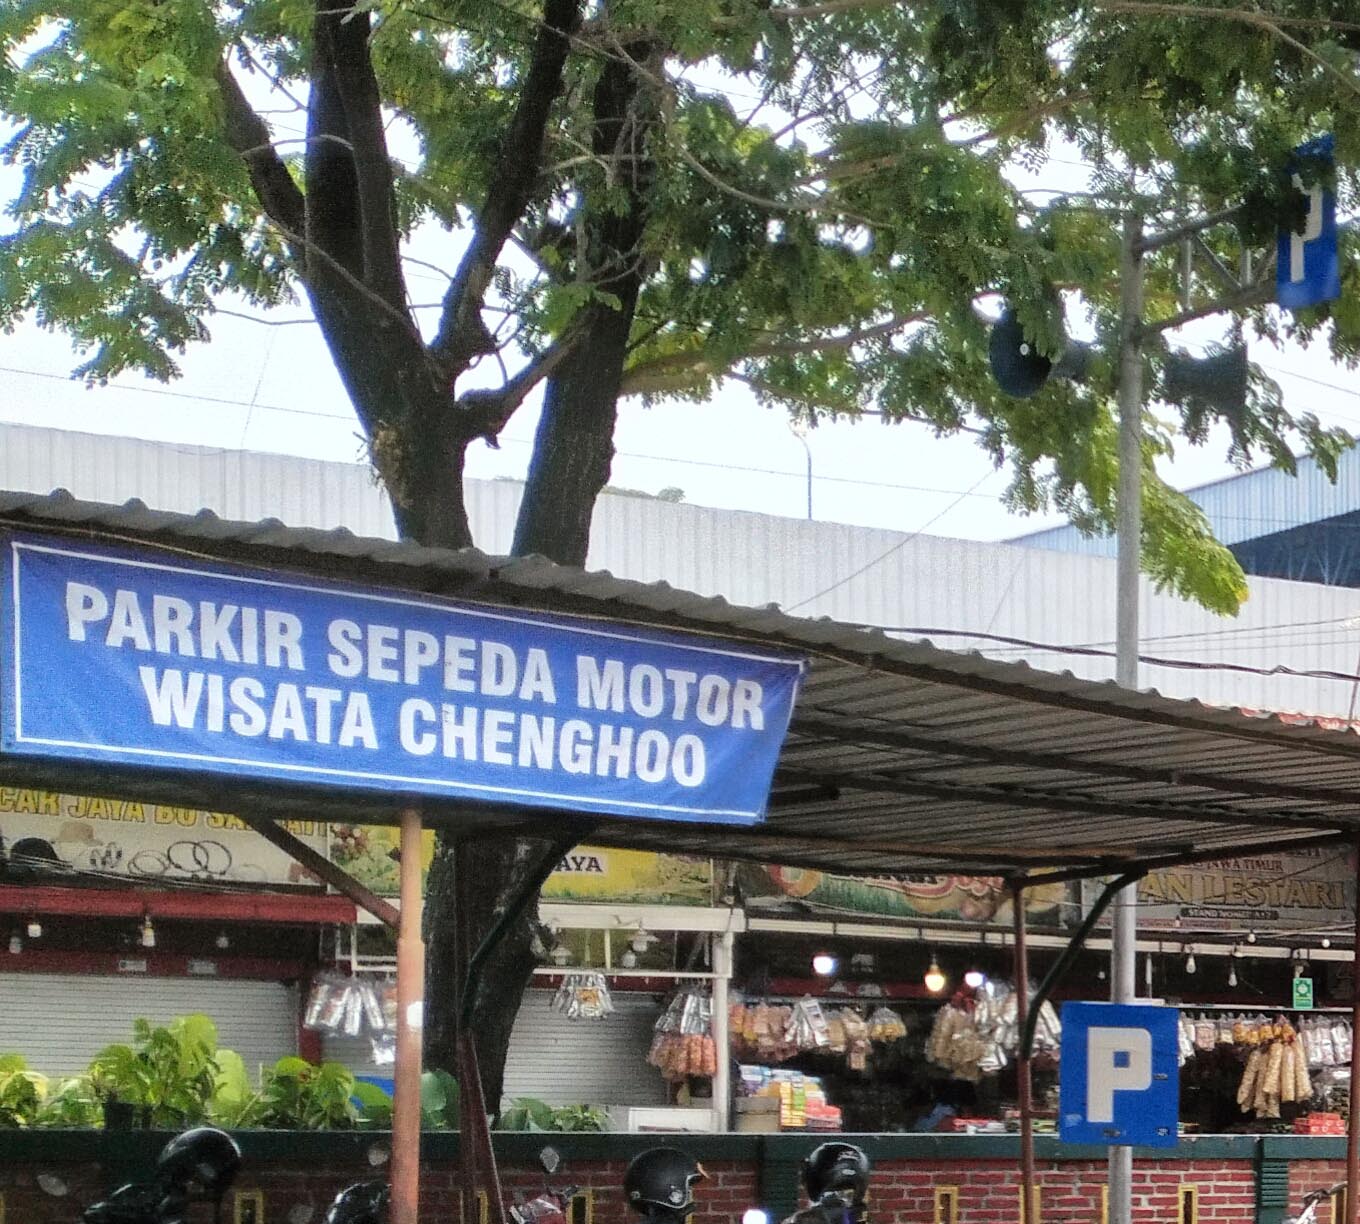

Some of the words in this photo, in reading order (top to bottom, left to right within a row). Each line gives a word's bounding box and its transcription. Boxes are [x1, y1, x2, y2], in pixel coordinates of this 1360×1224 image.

[66, 581, 304, 670] PARKIR
[327, 619, 556, 705] SEPEDA
[576, 654, 766, 731] MOTOR
[139, 665, 378, 750] WISATA
[400, 697, 706, 787] CHENGHOO
[555, 856, 603, 872] AYA
[1202, 874, 1346, 909] LESTARI
[1086, 1026, 1152, 1123] P
